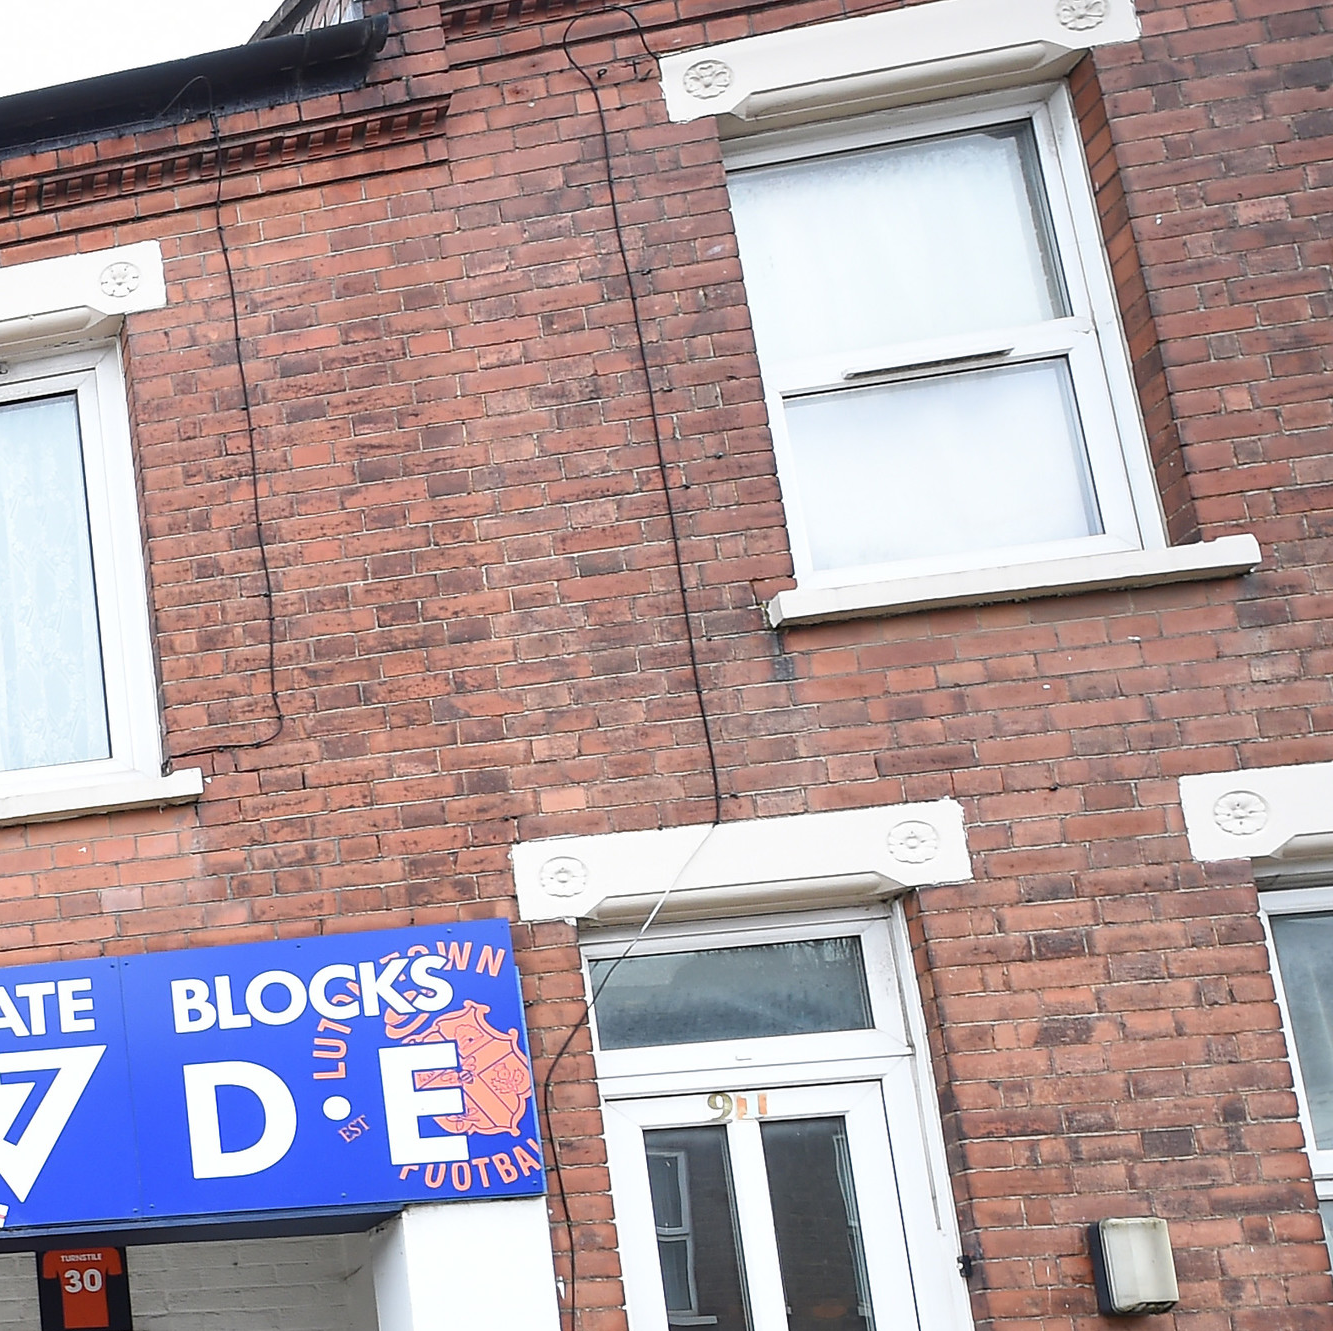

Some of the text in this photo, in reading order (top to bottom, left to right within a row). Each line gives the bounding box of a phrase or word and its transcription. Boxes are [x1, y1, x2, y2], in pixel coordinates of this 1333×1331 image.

[171, 955, 454, 1034] BLOCKS
[0, 1067, 62, 1146] 7
[338, 1114, 370, 1143] EST
[399, 1137, 542, 1191] OOTBA
[61, 1253, 102, 1262] TURNSTILE
[64, 1268, 102, 1293] 30
